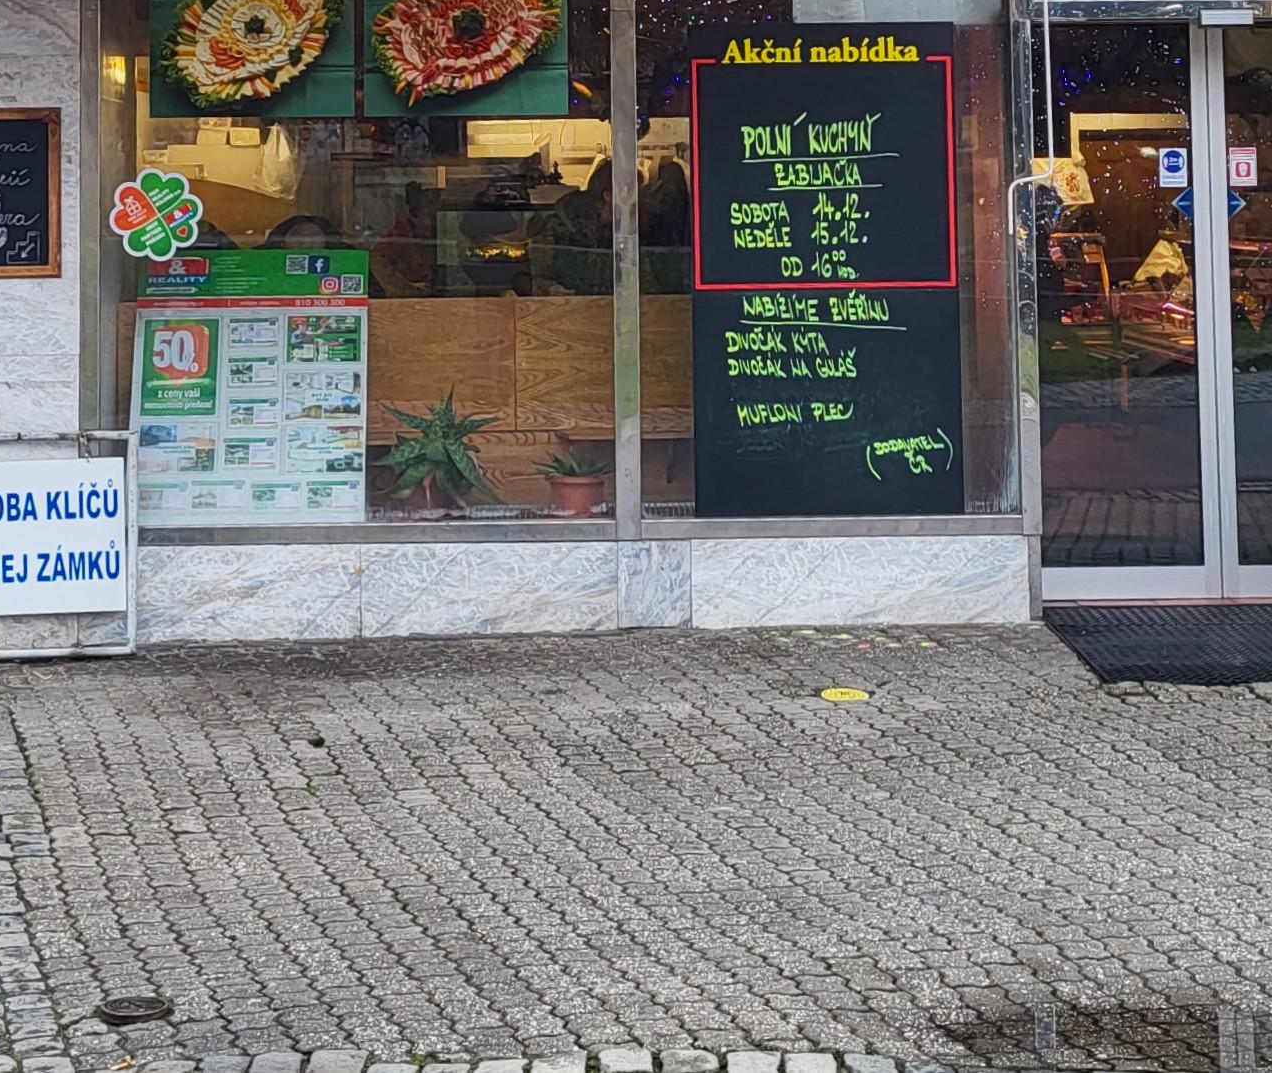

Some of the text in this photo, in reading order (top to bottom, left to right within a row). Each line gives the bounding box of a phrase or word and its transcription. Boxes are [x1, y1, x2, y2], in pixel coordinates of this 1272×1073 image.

[721, 36, 920, 64] Akční nabídka
[741, 111, 881, 158] POLNÍ KUCHYŇ
[774, 158, 863, 187] ZABIJAČKA
[730, 191, 870, 225] SOBOTA 14.12.
[734, 221, 868, 248] NEDĚLE 15.12.
[782, 256, 803, 277] OD
[743, 292, 819, 321] NABÍZÍME
[152, 330, 199, 373] 50%
[725, 326, 787, 353] DIVOČÁK
[728, 346, 857, 378] DIVOČÁK NA GULÁŠ
[46, 479, 119, 520] KLÍČŮ
[36, 540, 120, 582] ZÁMKŮ
